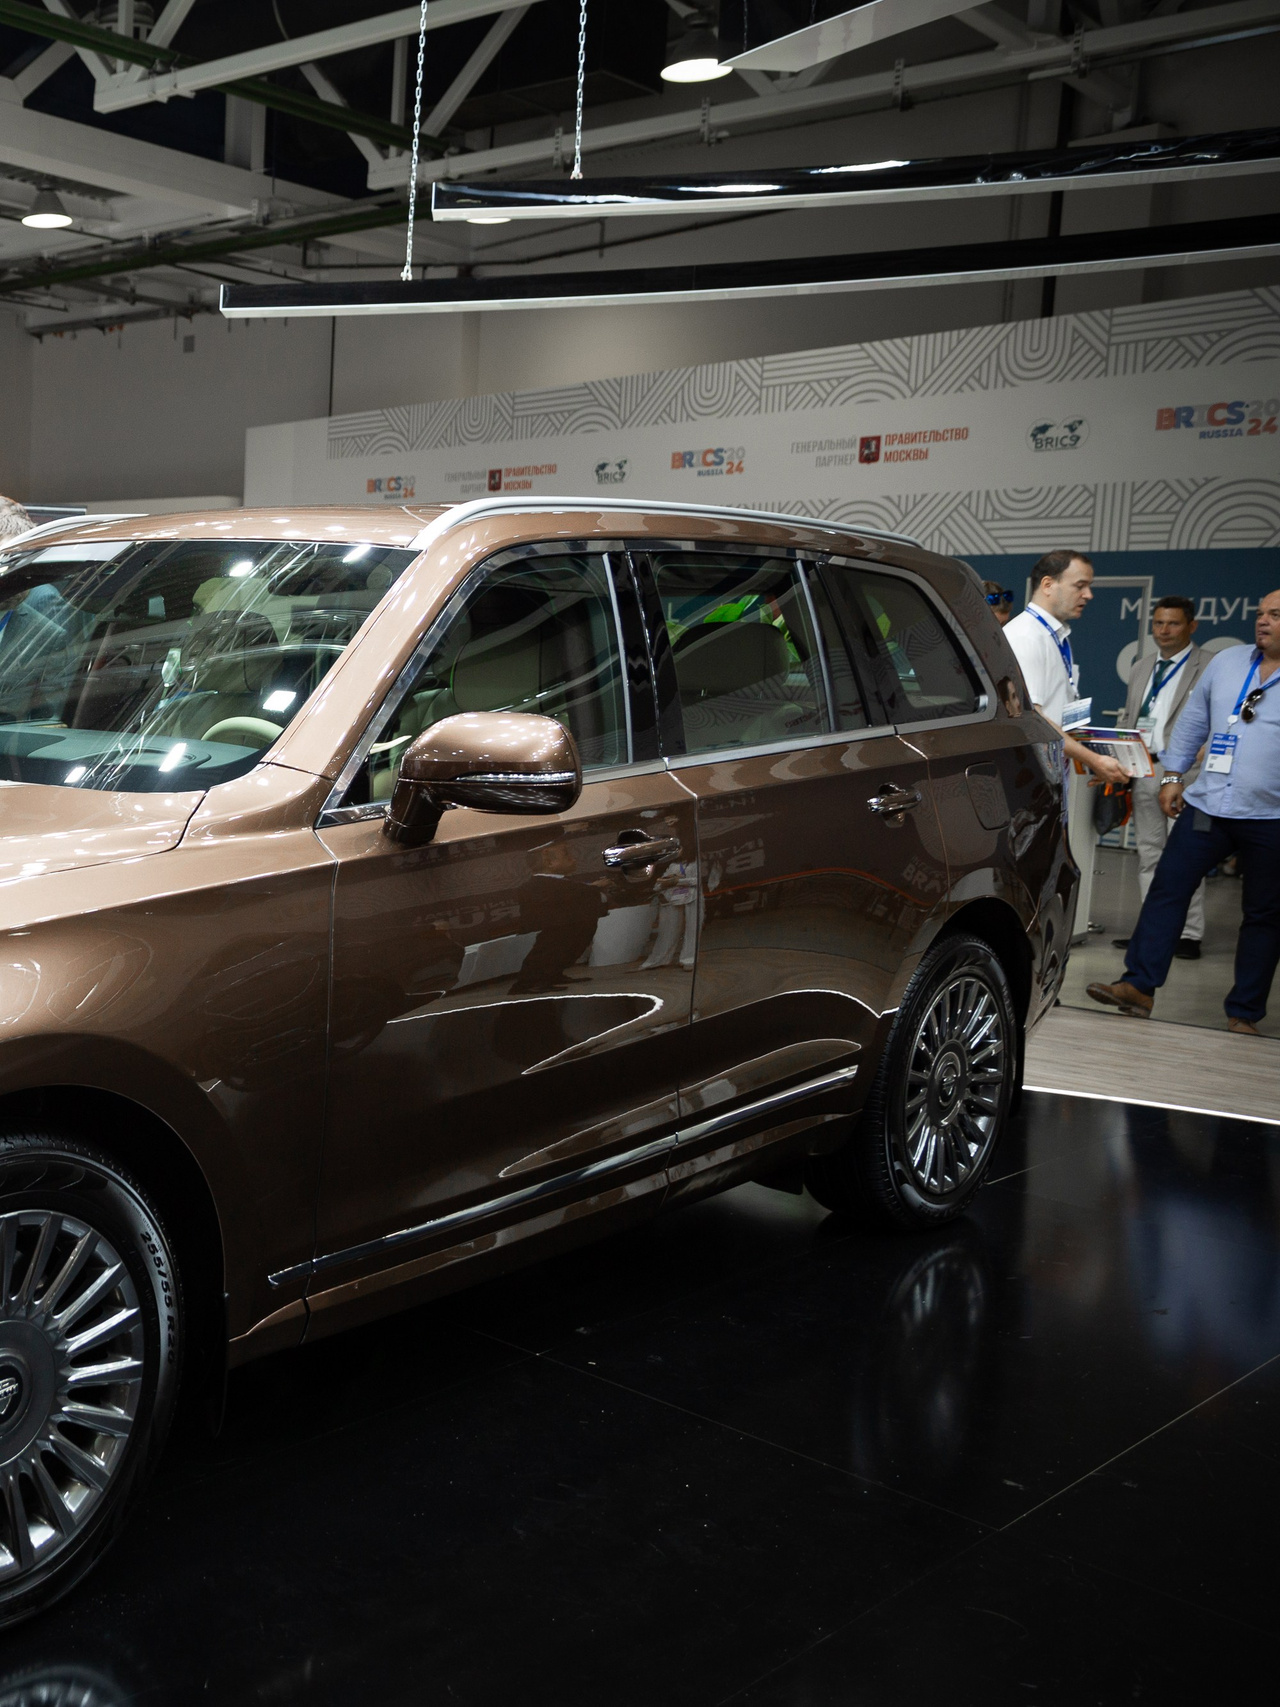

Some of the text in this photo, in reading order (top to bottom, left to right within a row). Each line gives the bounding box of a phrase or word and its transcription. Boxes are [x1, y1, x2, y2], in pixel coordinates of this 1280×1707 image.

[1155, 401, 1245, 431] BRICS
[1199, 417, 1278, 439] RUSSIA 24
[791, 427, 969, 454] ГЕНЕРАЛЬНЫЙ ПРАВИТЕЛЬСТВО
[671, 448, 725, 469] BRICS
[815, 448, 929, 467] ПАРТНЕР МОСКВЫ
[504, 464, 557, 477] ПРАВИТЕЛЬСТВО
[697, 461, 744, 477] RUSSIA 24
[504, 480, 532, 491] МОСКВЫ
[140, 1231, 173, 1308] 255/55
